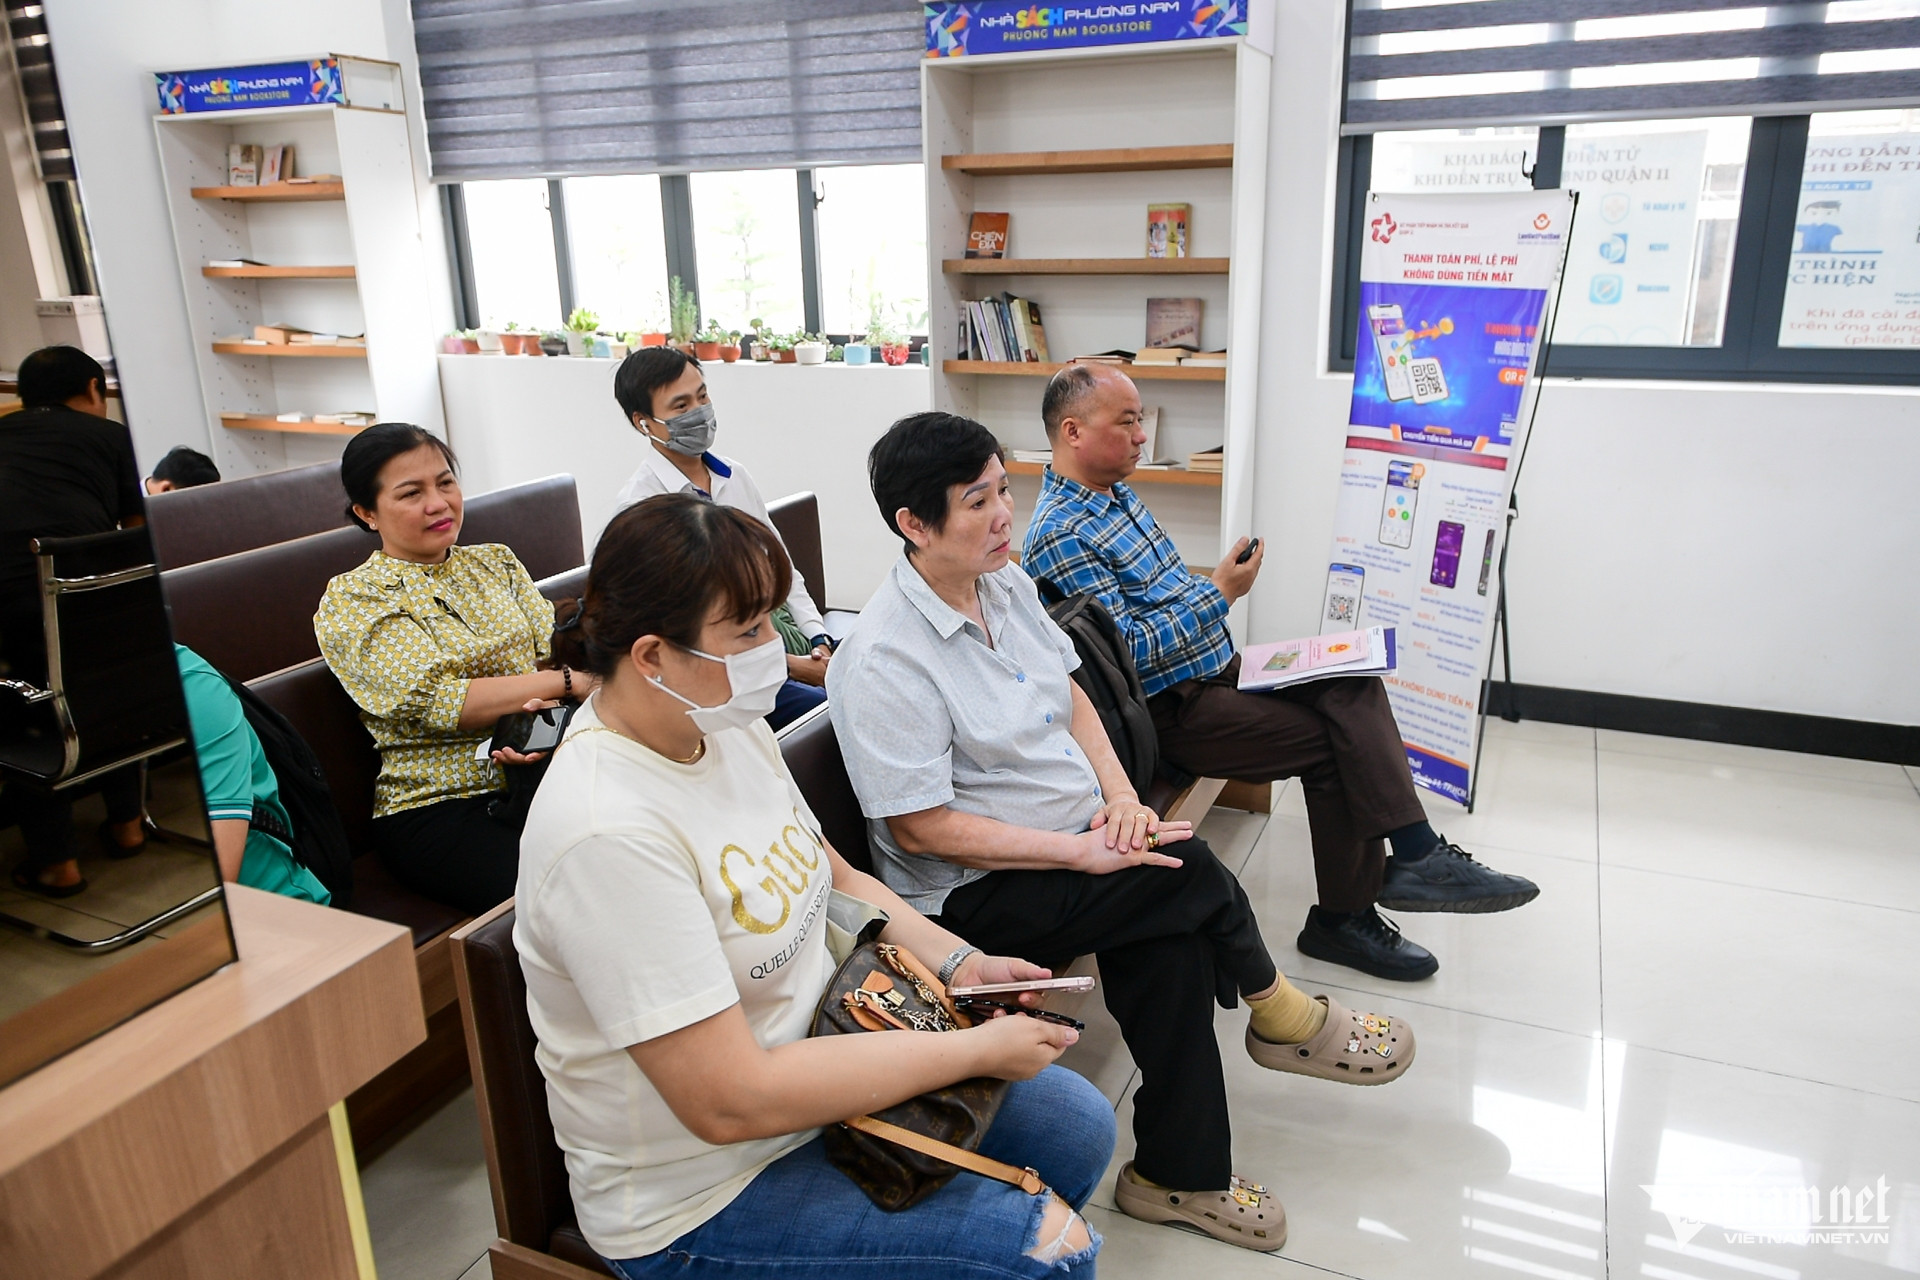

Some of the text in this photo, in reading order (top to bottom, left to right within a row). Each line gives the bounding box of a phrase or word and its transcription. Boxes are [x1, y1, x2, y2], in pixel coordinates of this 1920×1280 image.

[980, 12, 1015, 28] NHÀ
[1016, 4, 1064, 29] SÁCH
[1140, 1, 1180, 15] NAM
[1053, 26, 1077, 37] NAM
[1082, 20, 1152, 36] BOOKSTORE
[210, 76, 239, 94] SÁCH
[280, 76, 304, 87] NAM
[1444, 152, 1485, 167] KHAI
[1490, 148, 1523, 165] BÁO
[1859, 142, 1911, 158] DẪN
[1809, 162, 1836, 173] HI
[1843, 157, 1892, 172] ĐẾN
[1413, 173, 1442, 187] KHI
[1447, 167, 1480, 186] ĐẾN
[1484, 172, 1519, 187] TRỤ
[1562, 169, 1598, 182] BND
[1601, 166, 1652, 184] QUẬN
[971, 230, 1004, 242] CHIẾN
[1403, 253, 1433, 264] THANH
[1437, 253, 1462, 265] TOÁN
[1486, 253, 1498, 267] LỆ
[1500, 252, 1519, 266] PHÍ
[1795, 257, 1878, 270] TRÌNH
[1403, 269, 1435, 280] KHÔNG
[1813, 271, 1876, 287] HIỆN
[1806, 308, 1836, 319] Khi
[1841, 308, 1865, 319] đã
[1790, 320, 1828, 331] trên
[750, 936, 799, 979] QUELLE
